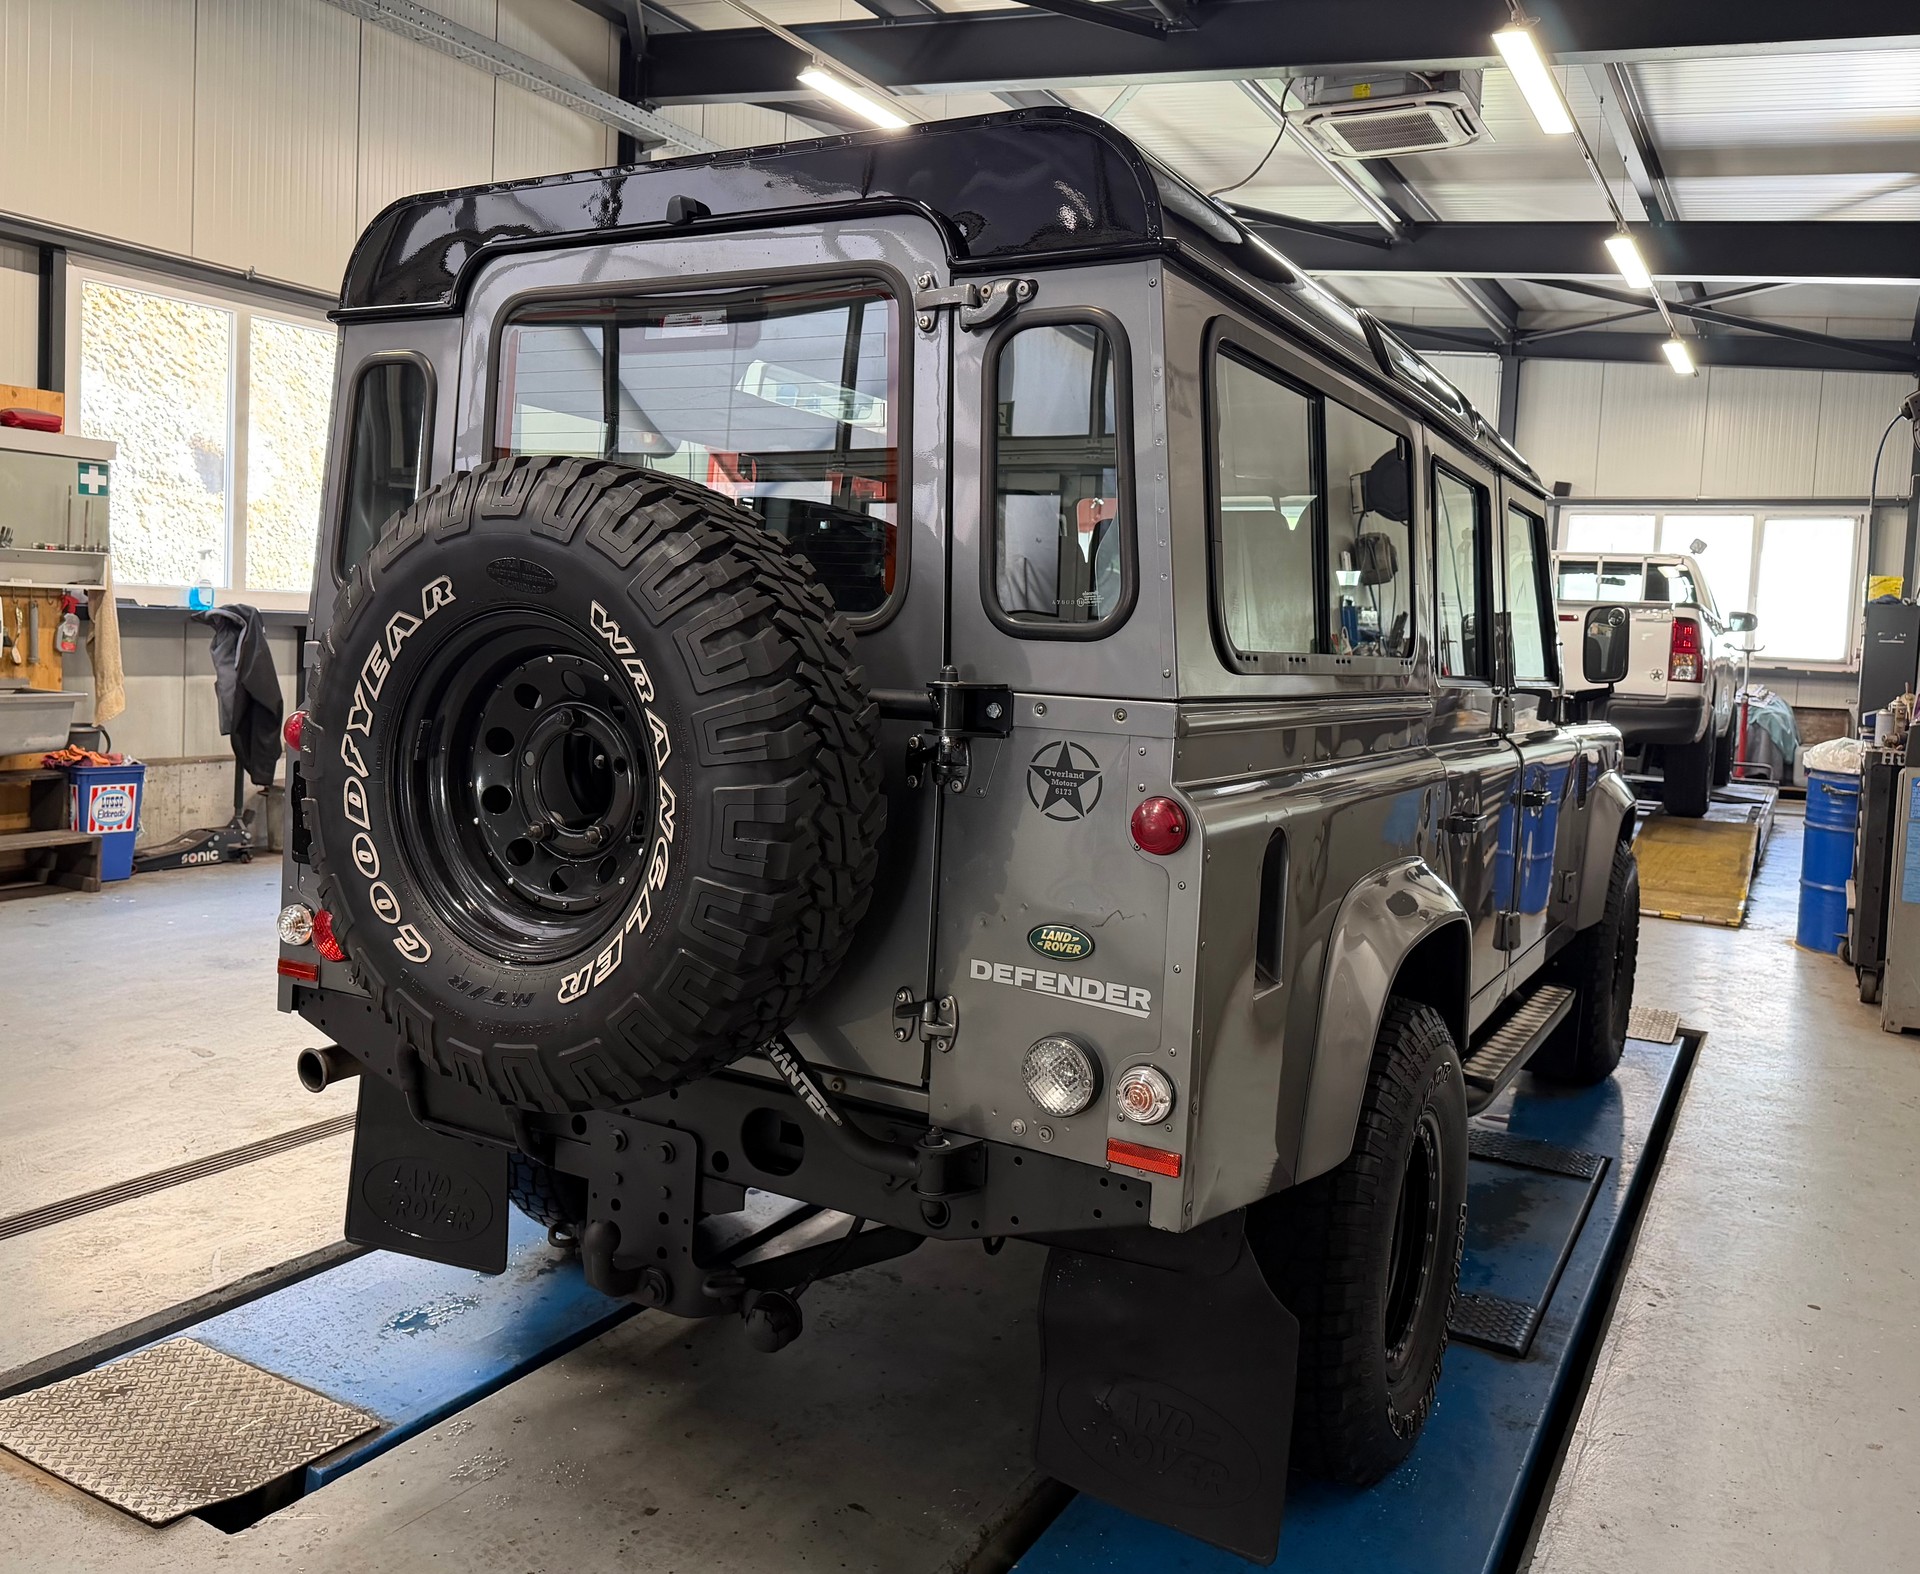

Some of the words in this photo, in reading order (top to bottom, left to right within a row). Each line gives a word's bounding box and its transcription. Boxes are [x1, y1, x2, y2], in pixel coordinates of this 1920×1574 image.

[341, 574, 456, 963] GOODYEAR
[1044, 768, 1085, 780] Overland
[1051, 778, 1078, 788] Motors
[1055, 787, 1072, 796] 6173
[97, 808, 126, 820] Eldorado
[101, 795, 124, 809] LUSSO
[558, 600, 677, 1005] WRANGLER
[1040, 929, 1071, 943] LAND
[1043, 940, 1082, 955] ROVER
[446, 974, 537, 1010] MT/R
[969, 958, 1152, 1011] DEFENDER
[760, 1035, 840, 1123] MANTEC
[392, 1164, 453, 1197] LAND
[395, 1192, 475, 1233] ROVER
